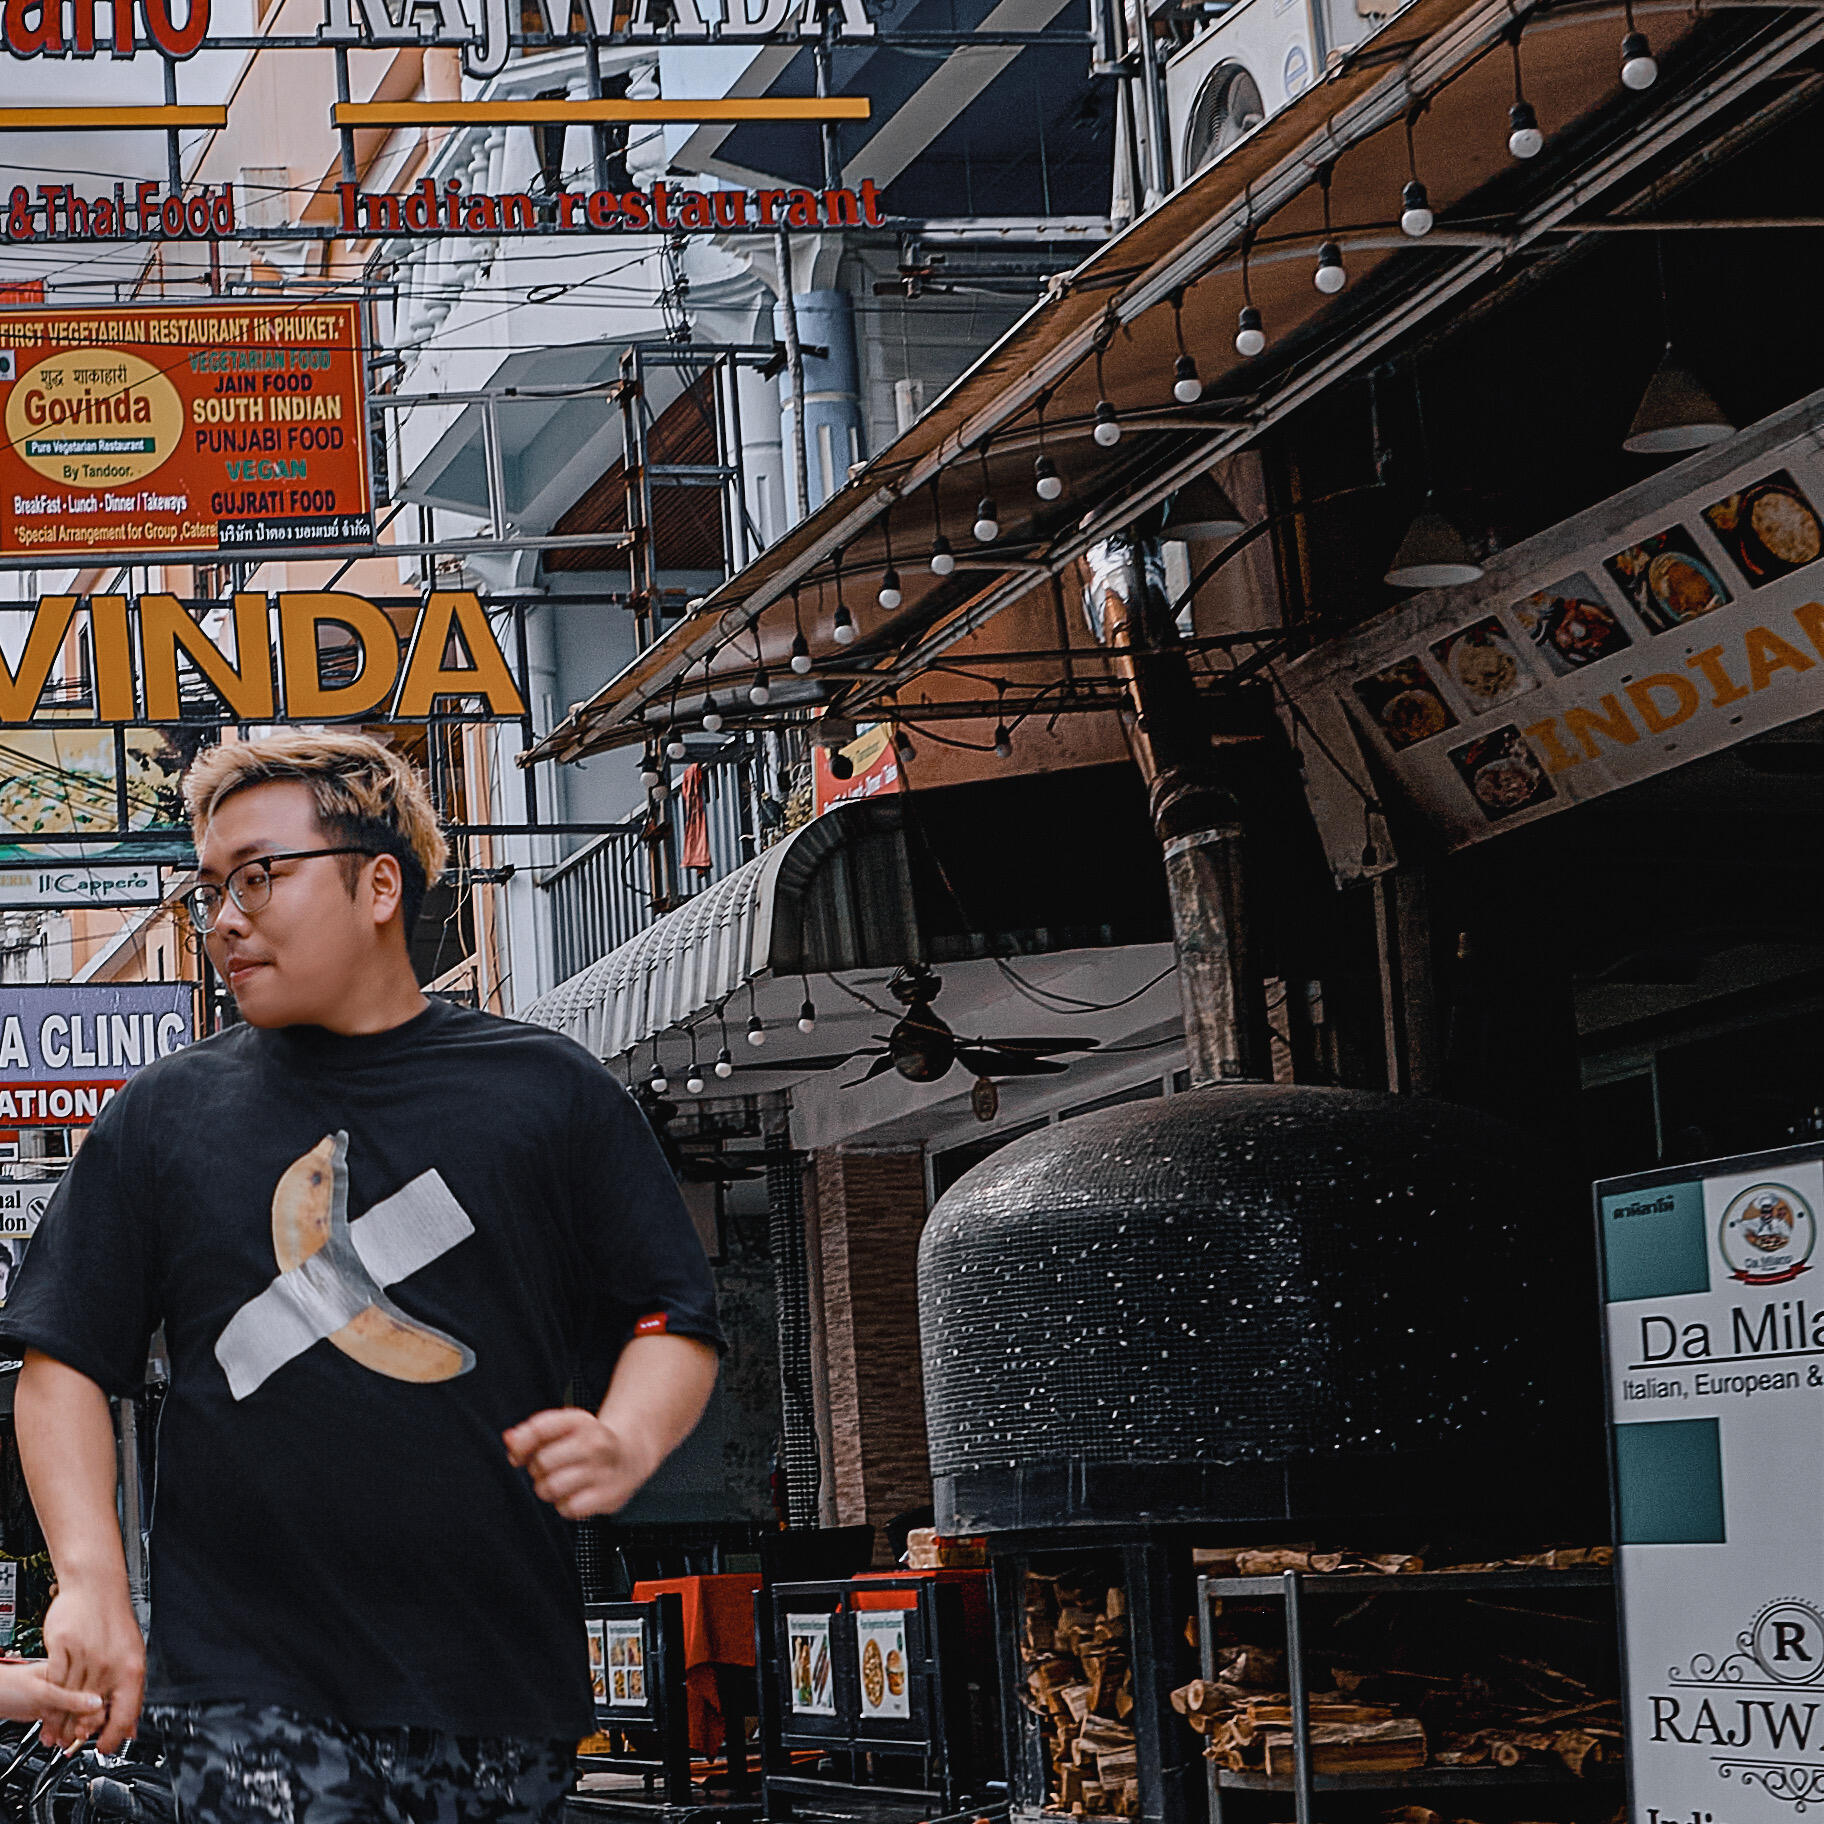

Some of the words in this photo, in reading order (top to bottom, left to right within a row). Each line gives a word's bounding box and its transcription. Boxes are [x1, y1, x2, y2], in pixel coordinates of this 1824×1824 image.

[135, 182, 237, 240] Food
[338, 181, 548, 236] Indian
[556, 179, 887, 236] restaurant
[48, 320, 146, 347] VEGETARIAN
[149, 317, 250, 344] RESTAURANT
[254, 317, 271, 342] IN
[188, 350, 286, 374] VEGETARIAN
[289, 349, 332, 371] FOOD
[214, 375, 257, 395] JAIN
[262, 373, 314, 393] FOOD
[23, 387, 152, 427] Govinda
[192, 396, 264, 424] SOUTH
[269, 394, 343, 422] INDIAN
[31, 441, 51, 454] Pure
[53, 440, 97, 455] Vegetarian
[98, 439, 145, 452] Restaurant
[195, 427, 282, 453] PUNJABI
[288, 426, 344, 451] FOOD
[63, 465, 79, 481] By
[226, 458, 308, 481] VEGAN
[67, 494, 98, 514] Lunch
[104, 492, 136, 514] Dinner
[142, 491, 188, 516] Takeways
[211, 490, 285, 516] GUJRATI
[290, 489, 337, 513] FOOD
[58, 523, 126, 545] Arrangement
[128, 522, 143, 540] for
[144, 521, 177, 542] Group
[39, 1012, 187, 1069] CLINIC
[1639, 1314, 1712, 1363] Da
[1622, 1377, 1689, 1401] Italian,
[1694, 1367, 1801, 1398] European
[1806, 1364, 1824, 1388] &
[1771, 1621, 1812, 1662] R
[1648, 1696, 1824, 1751] RAJW
